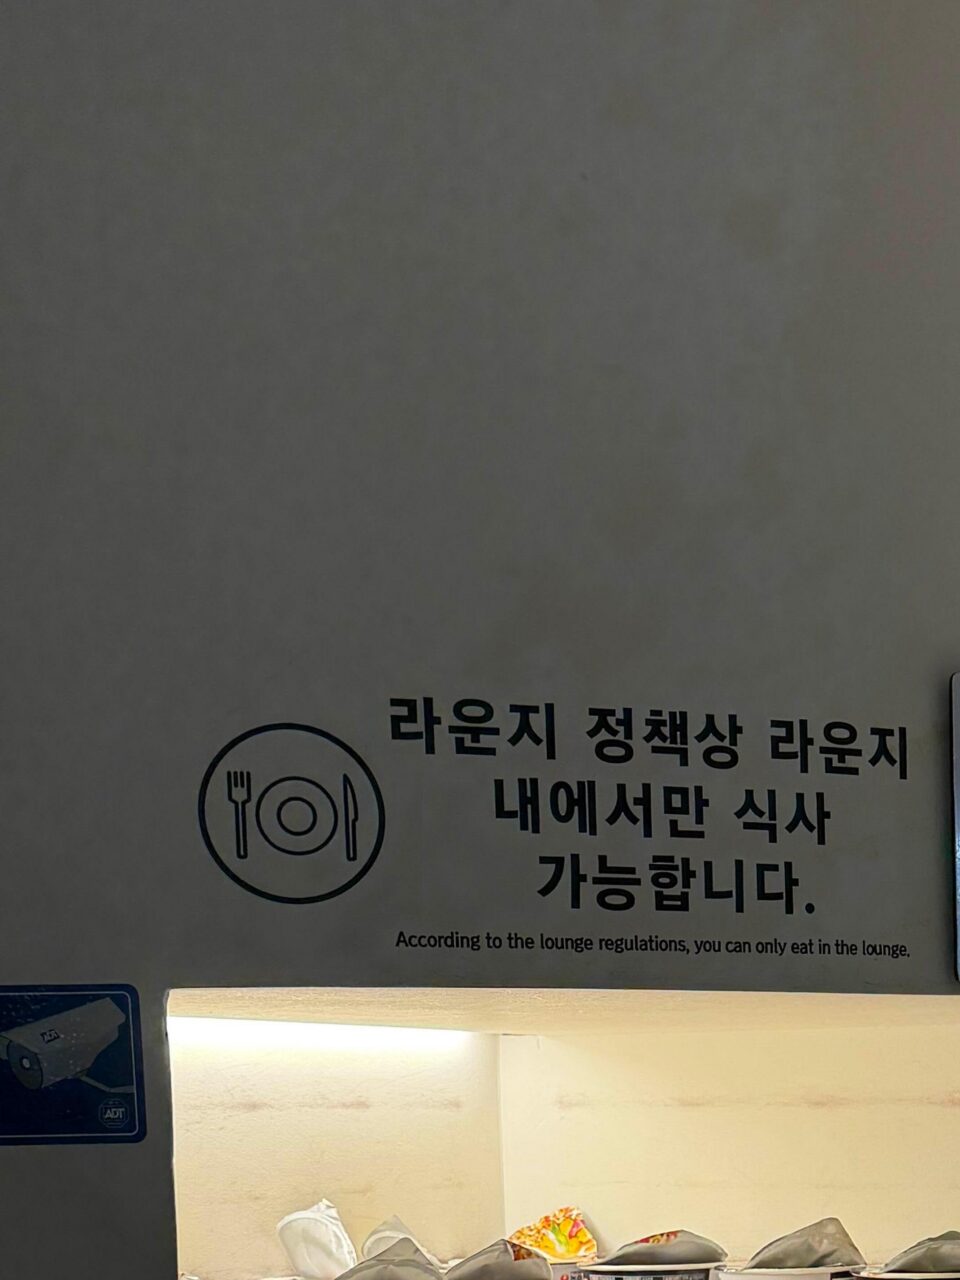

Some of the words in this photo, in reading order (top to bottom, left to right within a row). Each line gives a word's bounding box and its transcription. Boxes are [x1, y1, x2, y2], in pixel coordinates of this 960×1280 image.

[389, 696, 557, 761] 라운지
[585, 706, 744, 770] 정책상
[769, 718, 909, 781] 라운지
[493, 777, 710, 840] 내에서만
[733, 788, 832, 846] 식사
[536, 852, 817, 915] 가능합니다.
[395, 931, 481, 951] According
[485, 933, 502, 949] to
[507, 932, 535, 950] the
[540, 933, 593, 953] lounge
[599, 935, 690, 955] regulations,
[694, 938, 721, 955] you
[725, 940, 751, 953] can
[755, 938, 787, 956] only
[791, 939, 814, 955] eat
[818, 938, 831, 955] in
[834, 939, 858, 956] the
[862, 940, 911, 959] lounge.
[105, 1107, 125, 1119] ADT
